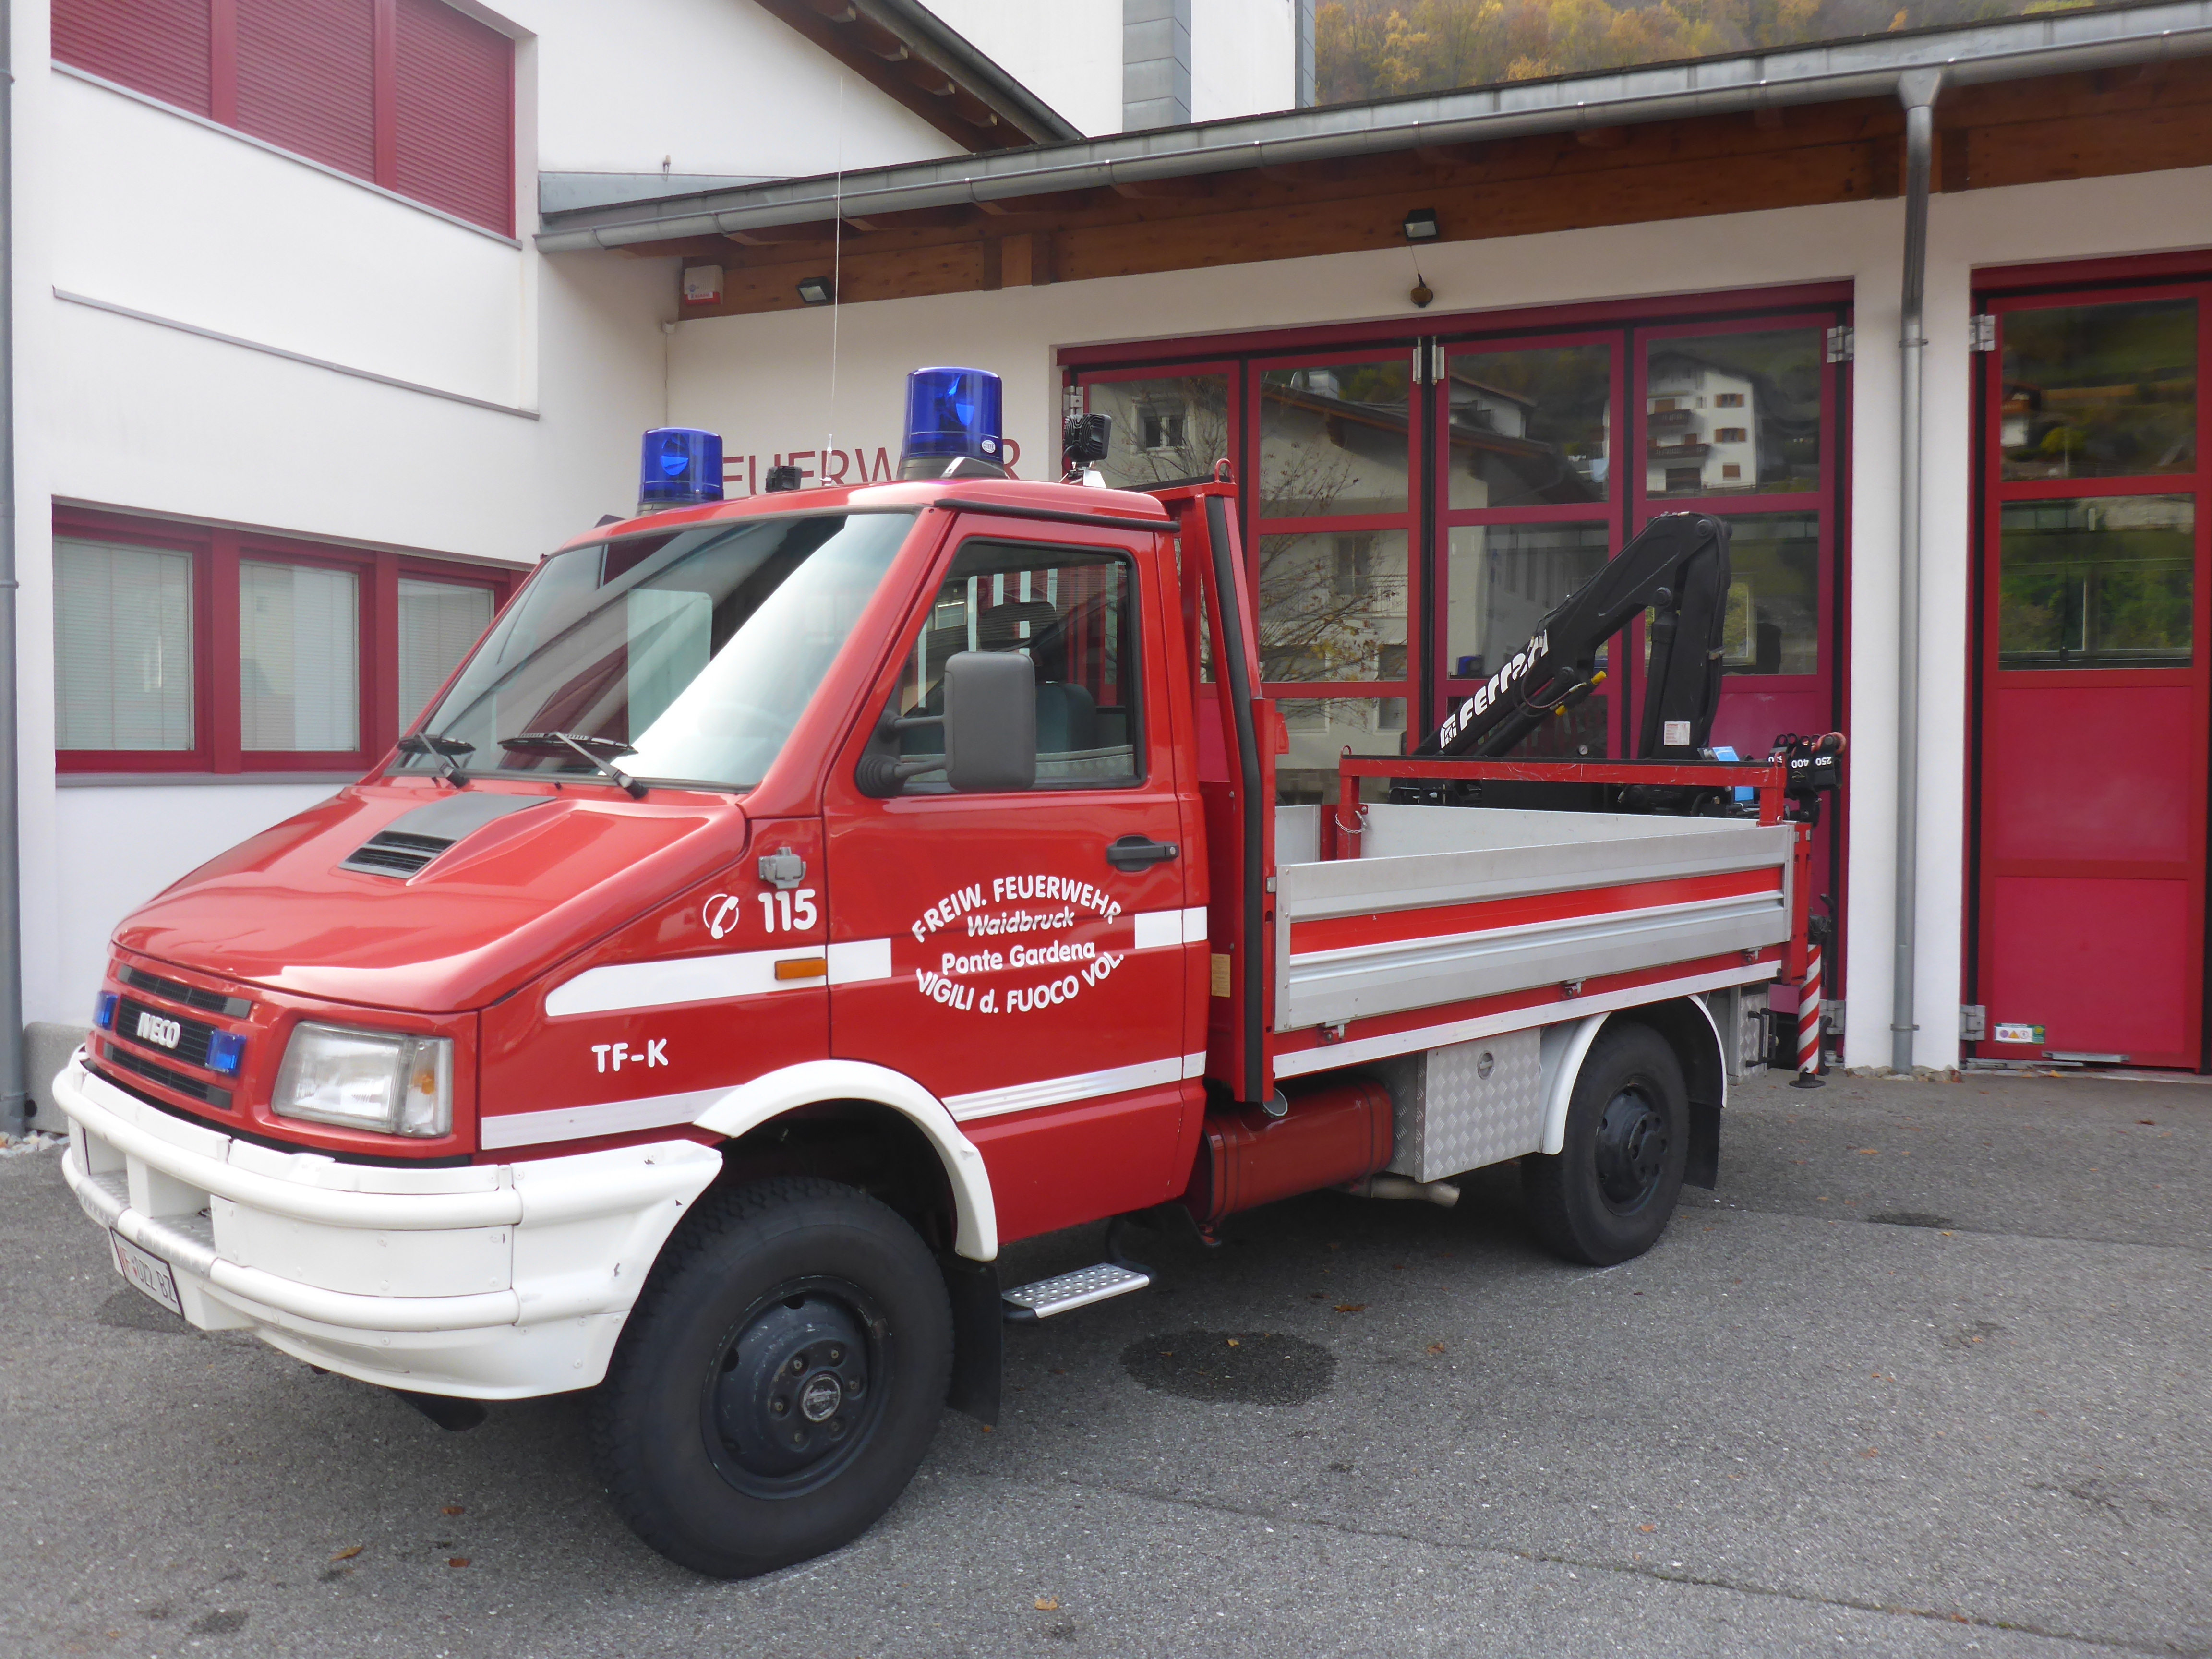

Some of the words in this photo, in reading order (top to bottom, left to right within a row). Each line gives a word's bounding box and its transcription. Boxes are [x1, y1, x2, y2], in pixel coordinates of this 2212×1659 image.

[1791, 758, 1809, 769] 400
[1815, 756, 1832, 766] 250
[758, 889, 817, 933] 115
[912, 883, 987, 943] FREIW.
[993, 875, 1121, 924] FEUERWEHR
[967, 906, 1075, 937] Waidbruck
[942, 949, 1003, 975] Ponte
[1010, 940, 1095, 967] Gardena
[916, 968, 974, 1011] VIGILI
[979, 989, 999, 1014] d.
[1007, 975, 1079, 1014] FUOCO
[1082, 951, 1124, 987] VOL.
[137, 1012, 180, 1049] IVECO
[591, 1038, 669, 1073] TF-K
